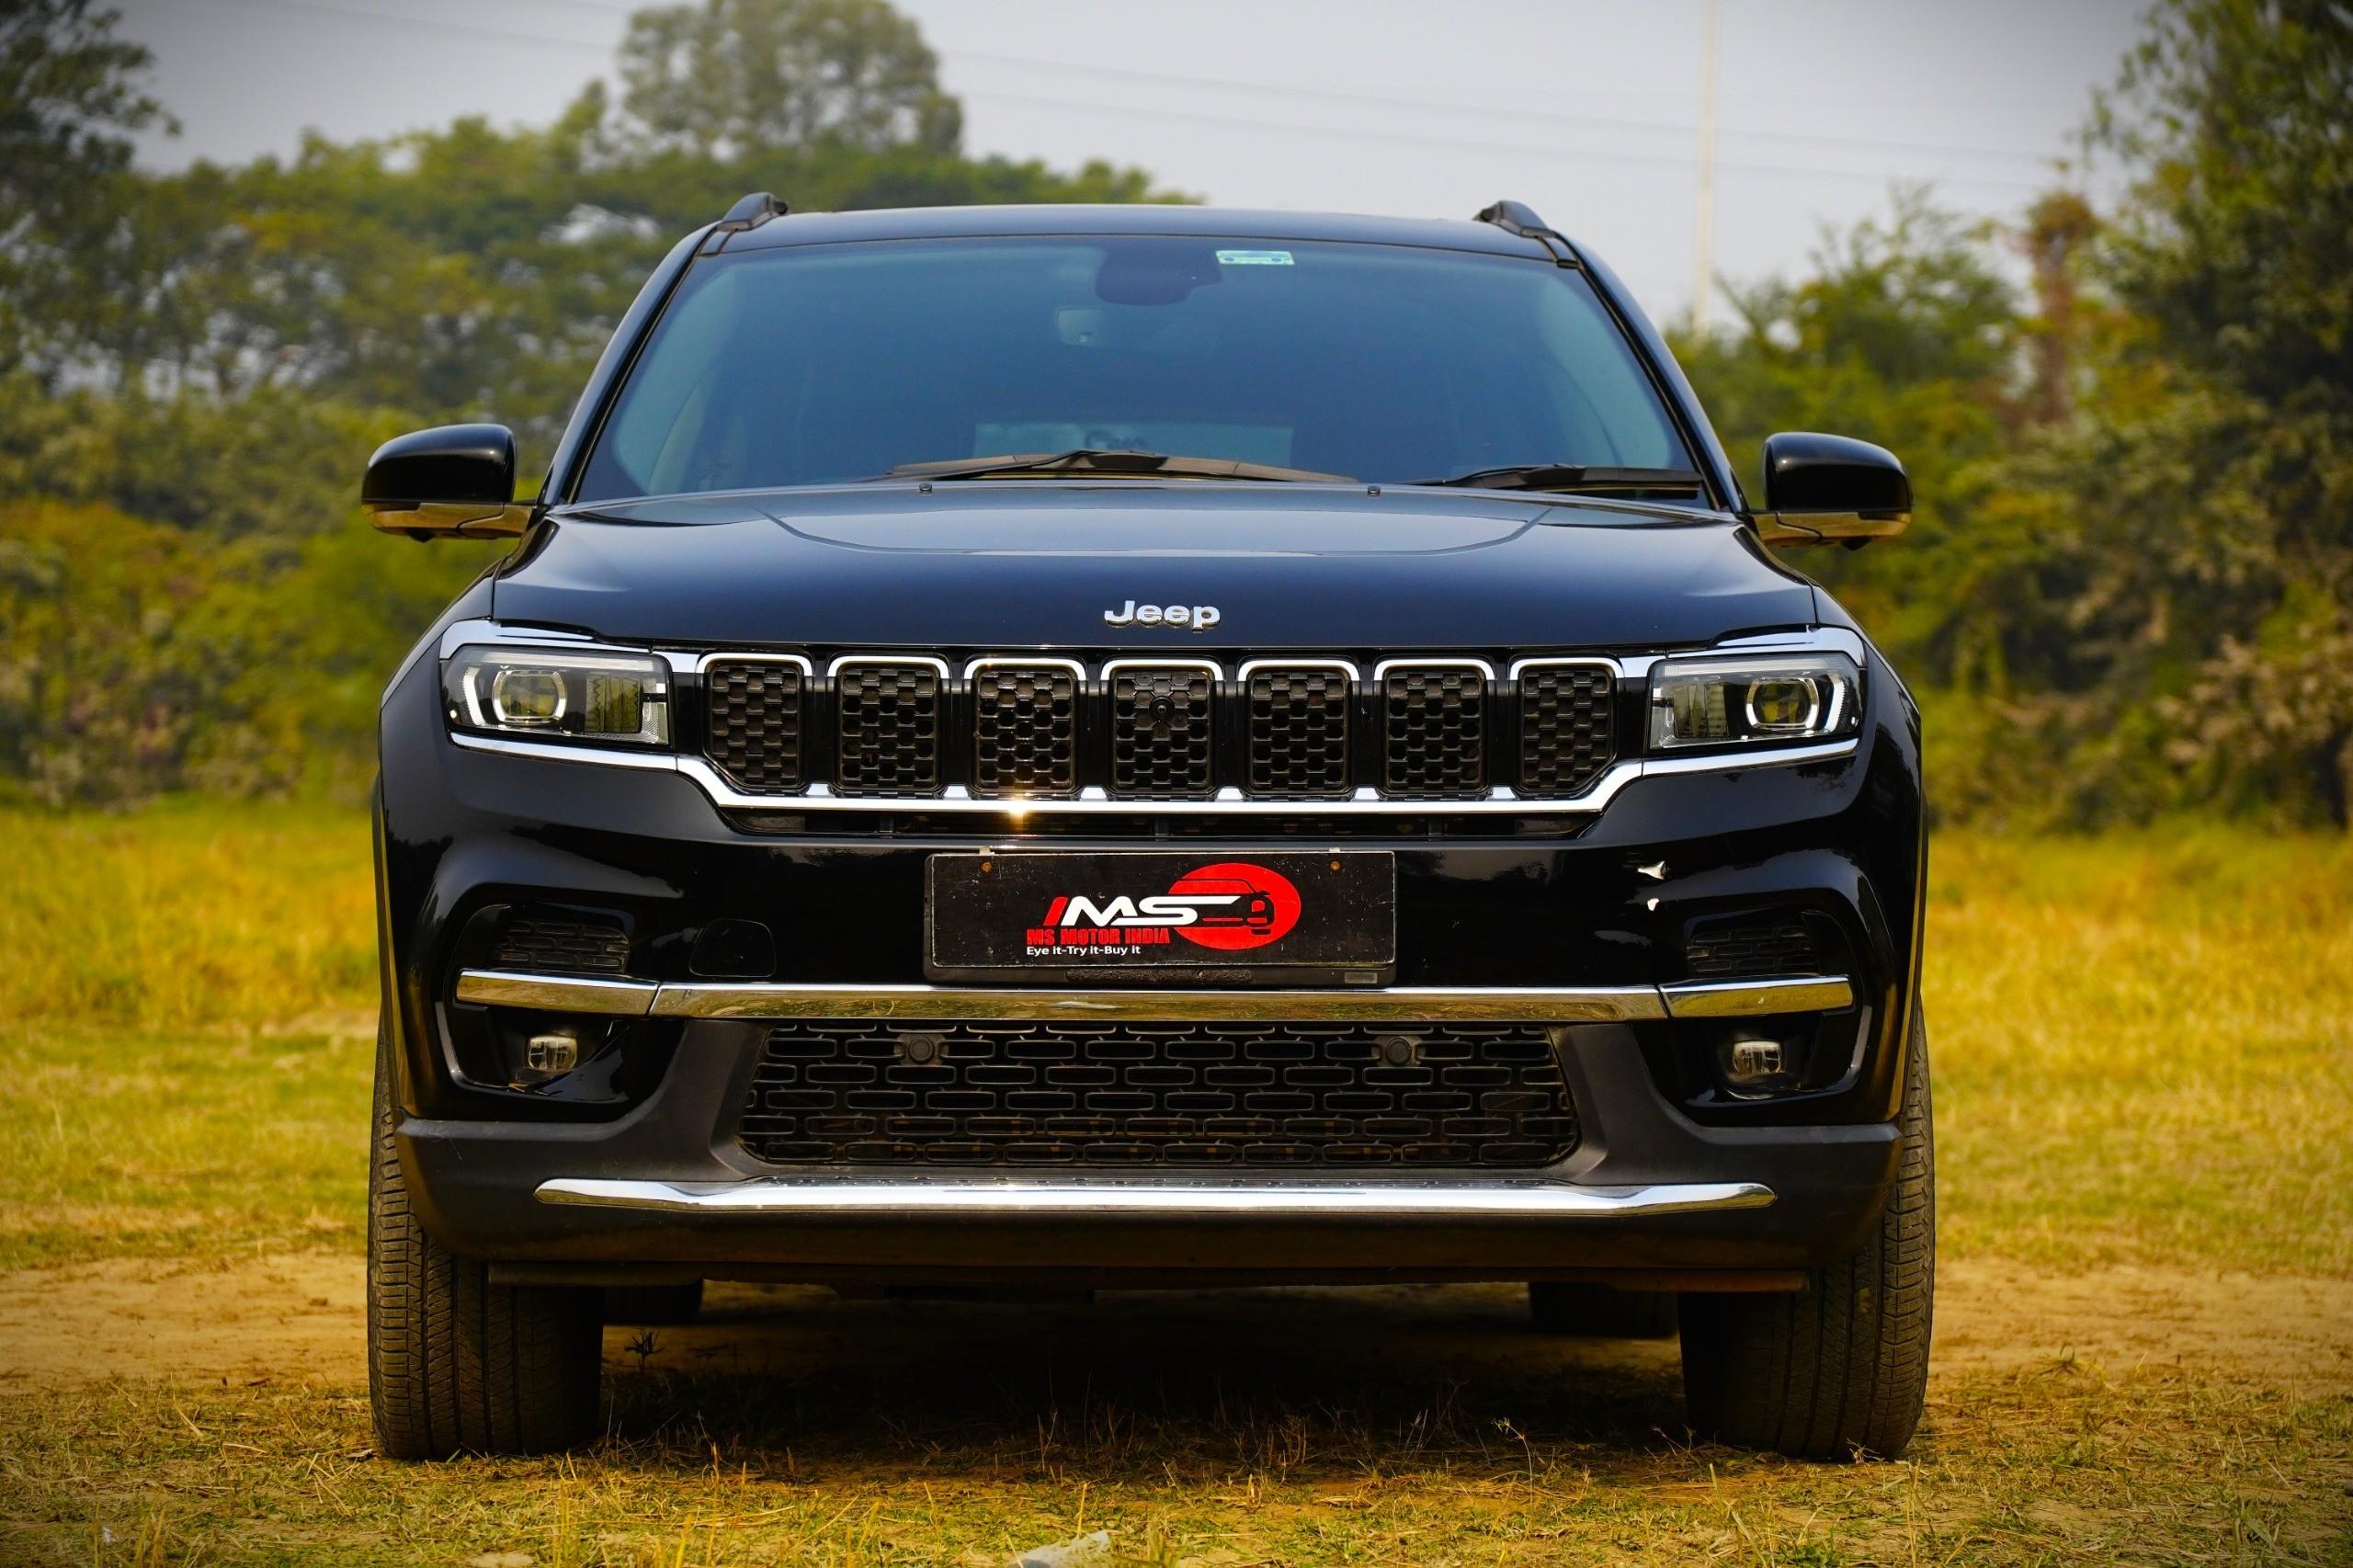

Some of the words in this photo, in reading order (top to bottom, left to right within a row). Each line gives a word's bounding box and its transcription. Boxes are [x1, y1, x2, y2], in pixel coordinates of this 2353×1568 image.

[1104, 600, 1221, 632] Jeep
[1026, 928, 1055, 945] MS
[1061, 928, 1120, 945] MOTOR
[1125, 927, 1171, 944] INDIA
[1026, 946, 1050, 957] Eye
[1052, 946, 1087, 956] it-Try
[1090, 946, 1128, 956] it-Buy
[1131, 946, 1142, 955] it
